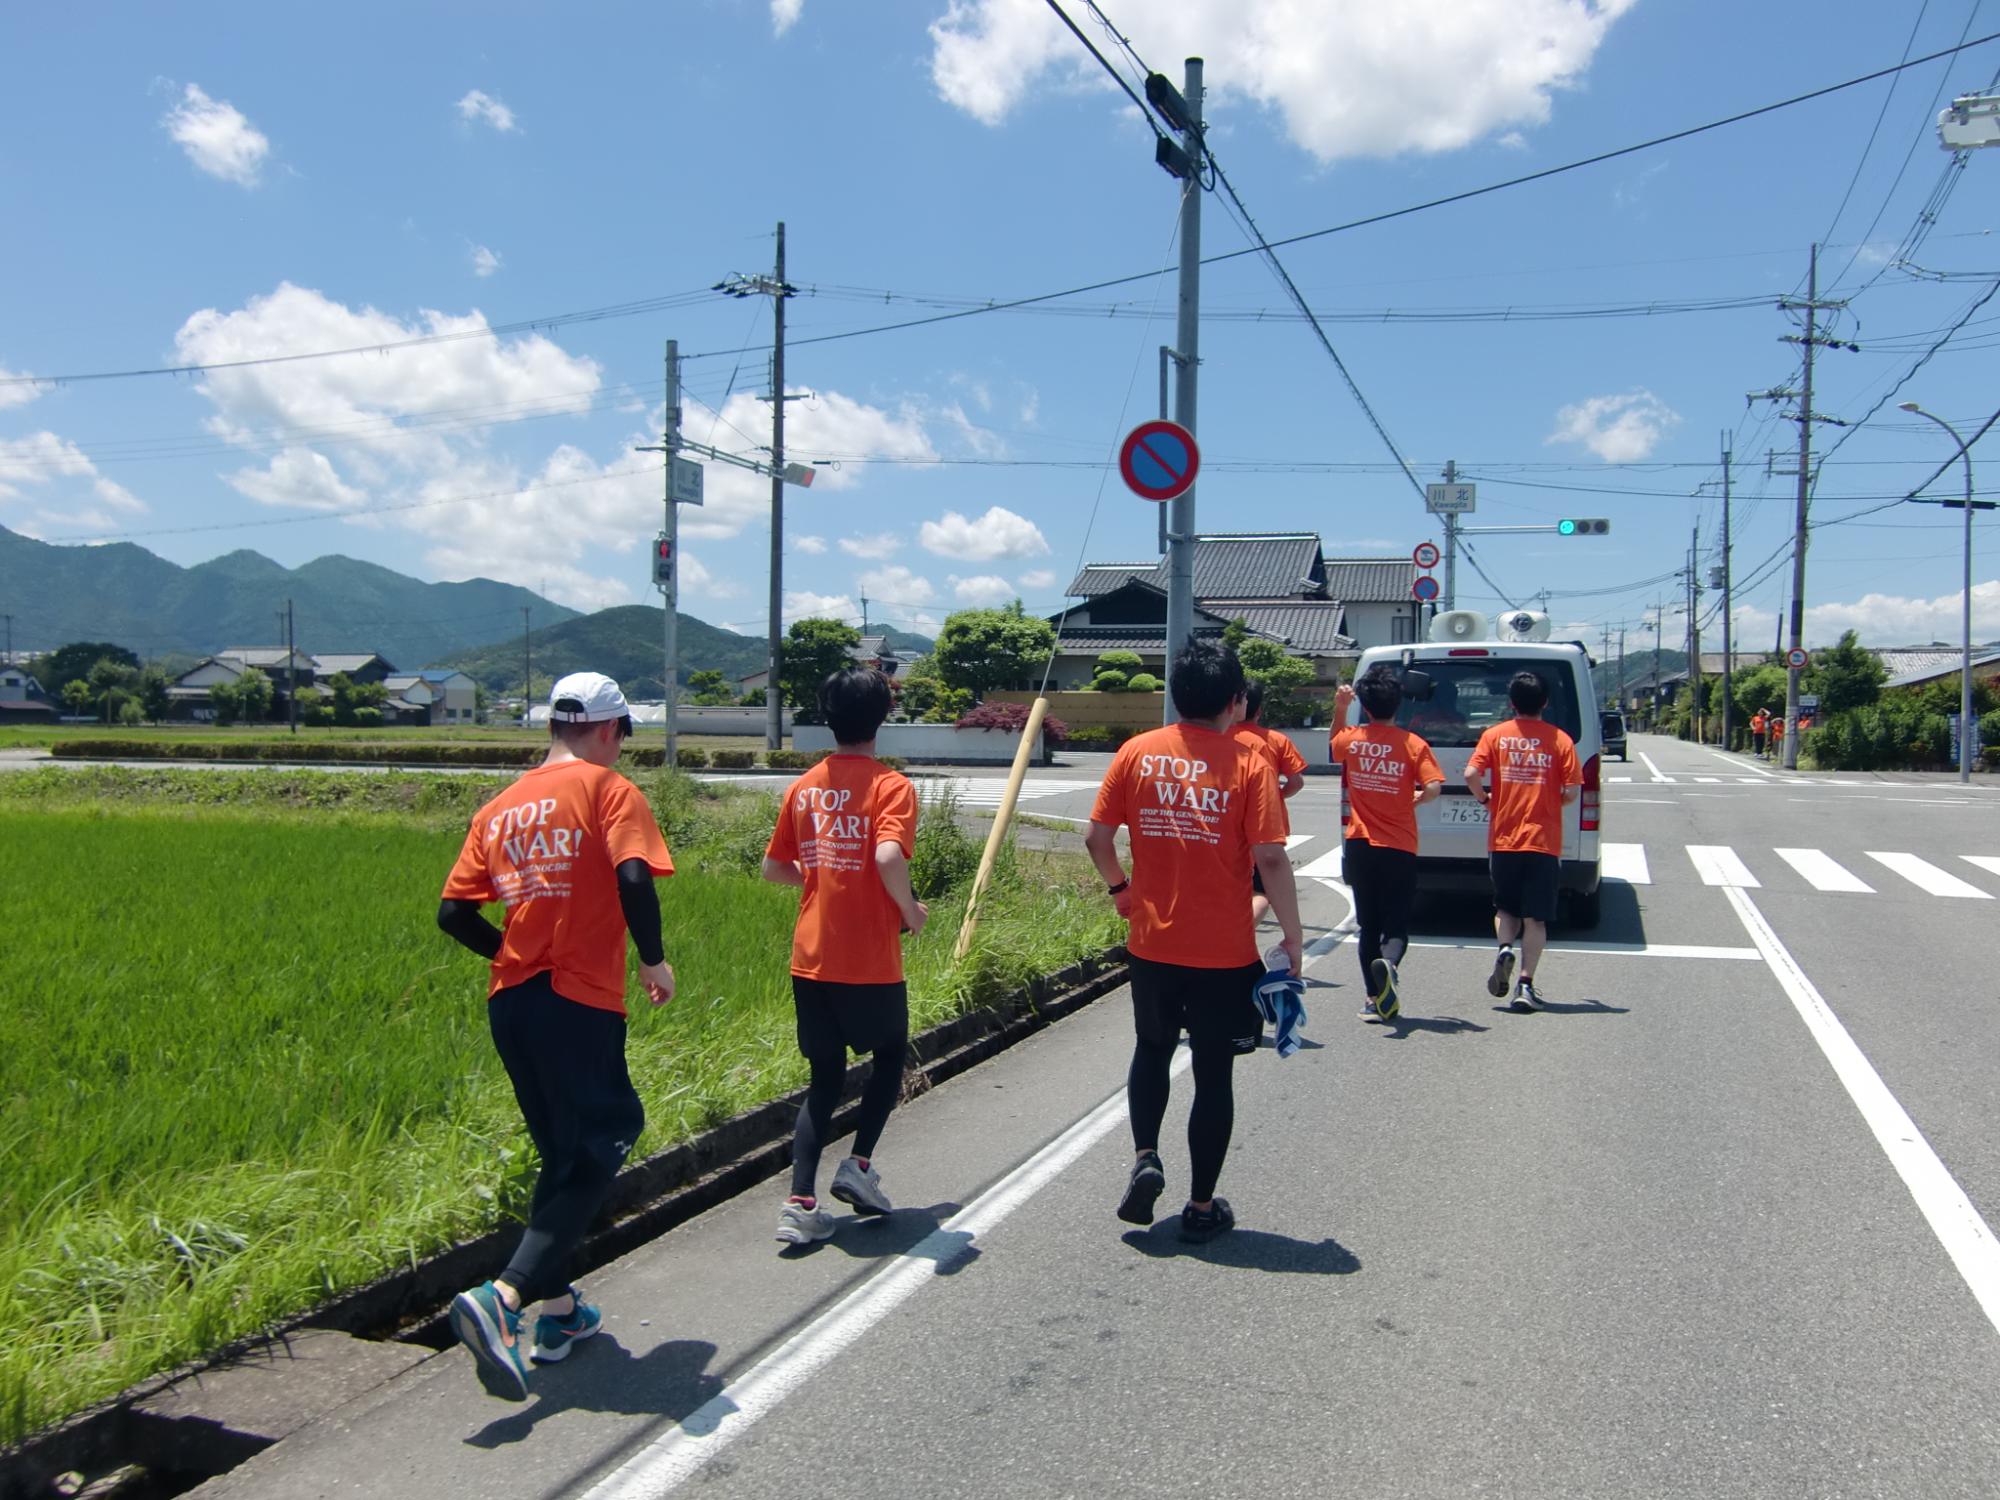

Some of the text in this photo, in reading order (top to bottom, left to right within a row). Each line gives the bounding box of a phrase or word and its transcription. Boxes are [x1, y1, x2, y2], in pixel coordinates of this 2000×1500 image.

[1348, 741, 1392, 758] STOP
[1499, 736, 1540, 751] STOP
[1140, 754, 1208, 782] STOP
[1359, 757, 1406, 776] WAR!
[1509, 752, 1552, 768] WAR!
[796, 786, 851, 811] STOP
[1155, 781, 1230, 813] WAR!
[487, 798, 557, 841] STOP
[503, 828, 583, 866] WAR!
